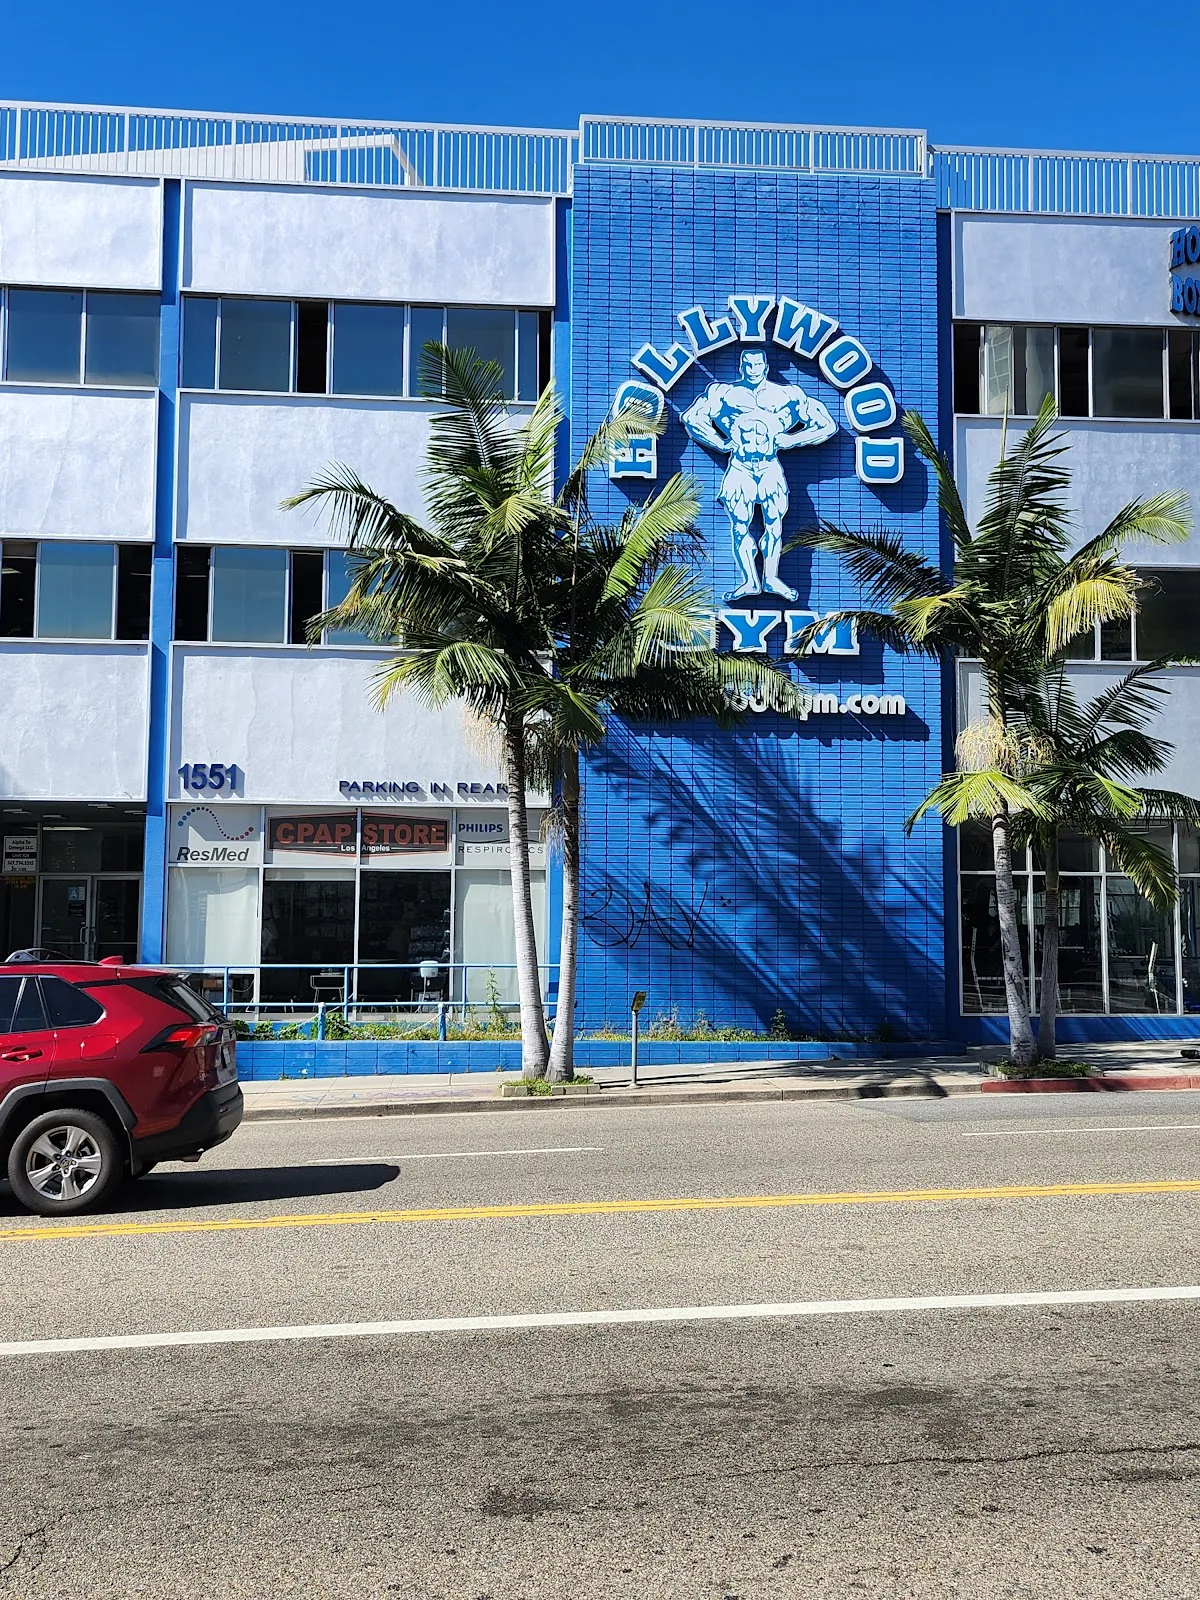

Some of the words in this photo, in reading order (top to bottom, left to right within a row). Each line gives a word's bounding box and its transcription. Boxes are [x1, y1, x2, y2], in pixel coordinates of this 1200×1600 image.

[609, 295, 904, 484] HOLLYWOOD
[177, 763, 237, 790] 1551
[339, 780, 419, 793] PARKING
[430, 782, 447, 793] IN
[276, 823, 352, 844] CPAP
[363, 824, 445, 846] STORE
[458, 823, 503, 833] PHILIPS
[177, 847, 249, 861] ResMed
[340, 844, 356, 852] Los
[361, 844, 391, 853] Angeles
[458, 846, 544, 854] RESPIROCS
